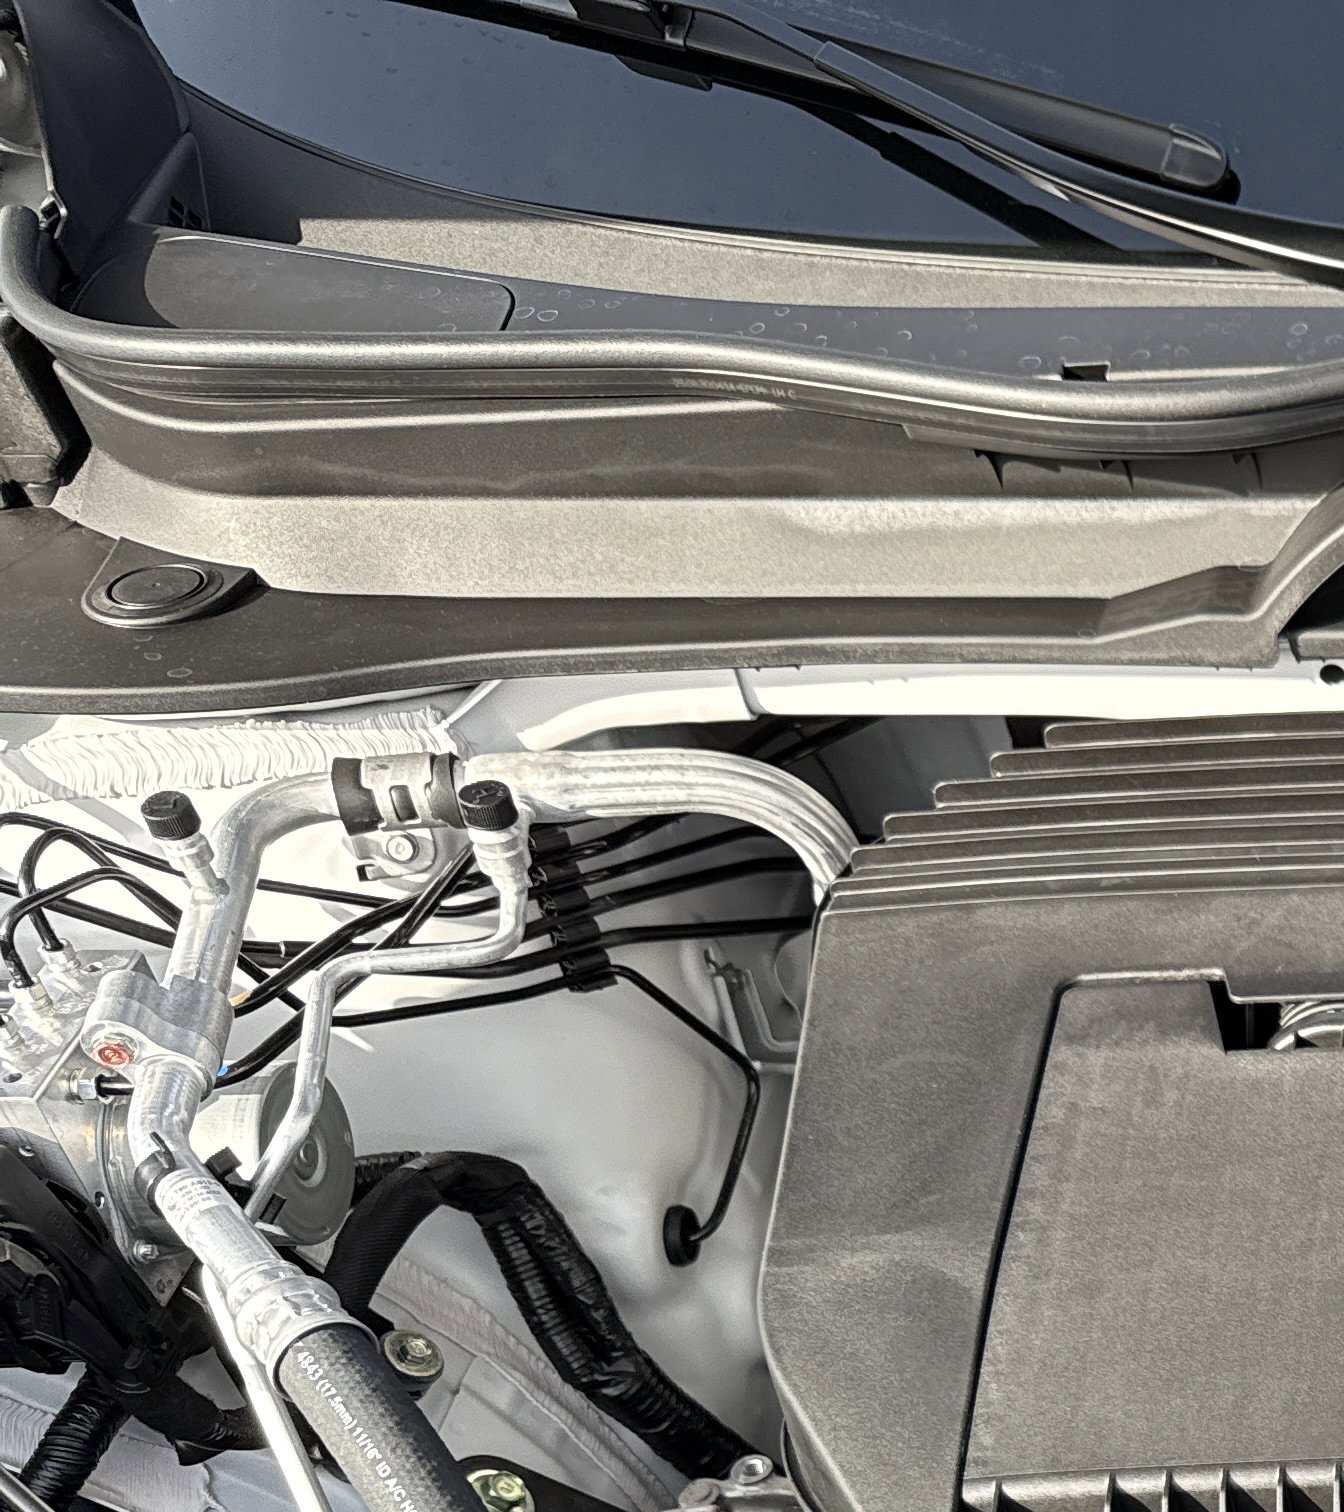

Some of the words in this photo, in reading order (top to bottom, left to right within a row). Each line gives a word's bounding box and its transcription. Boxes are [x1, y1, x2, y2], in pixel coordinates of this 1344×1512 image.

[297, 1351, 323, 1381] 4843
[315, 1379, 358, 1430] (17.5mm)
[376, 1461, 391, 1478] ID
[384, 1478, 406, 1502] A/C
